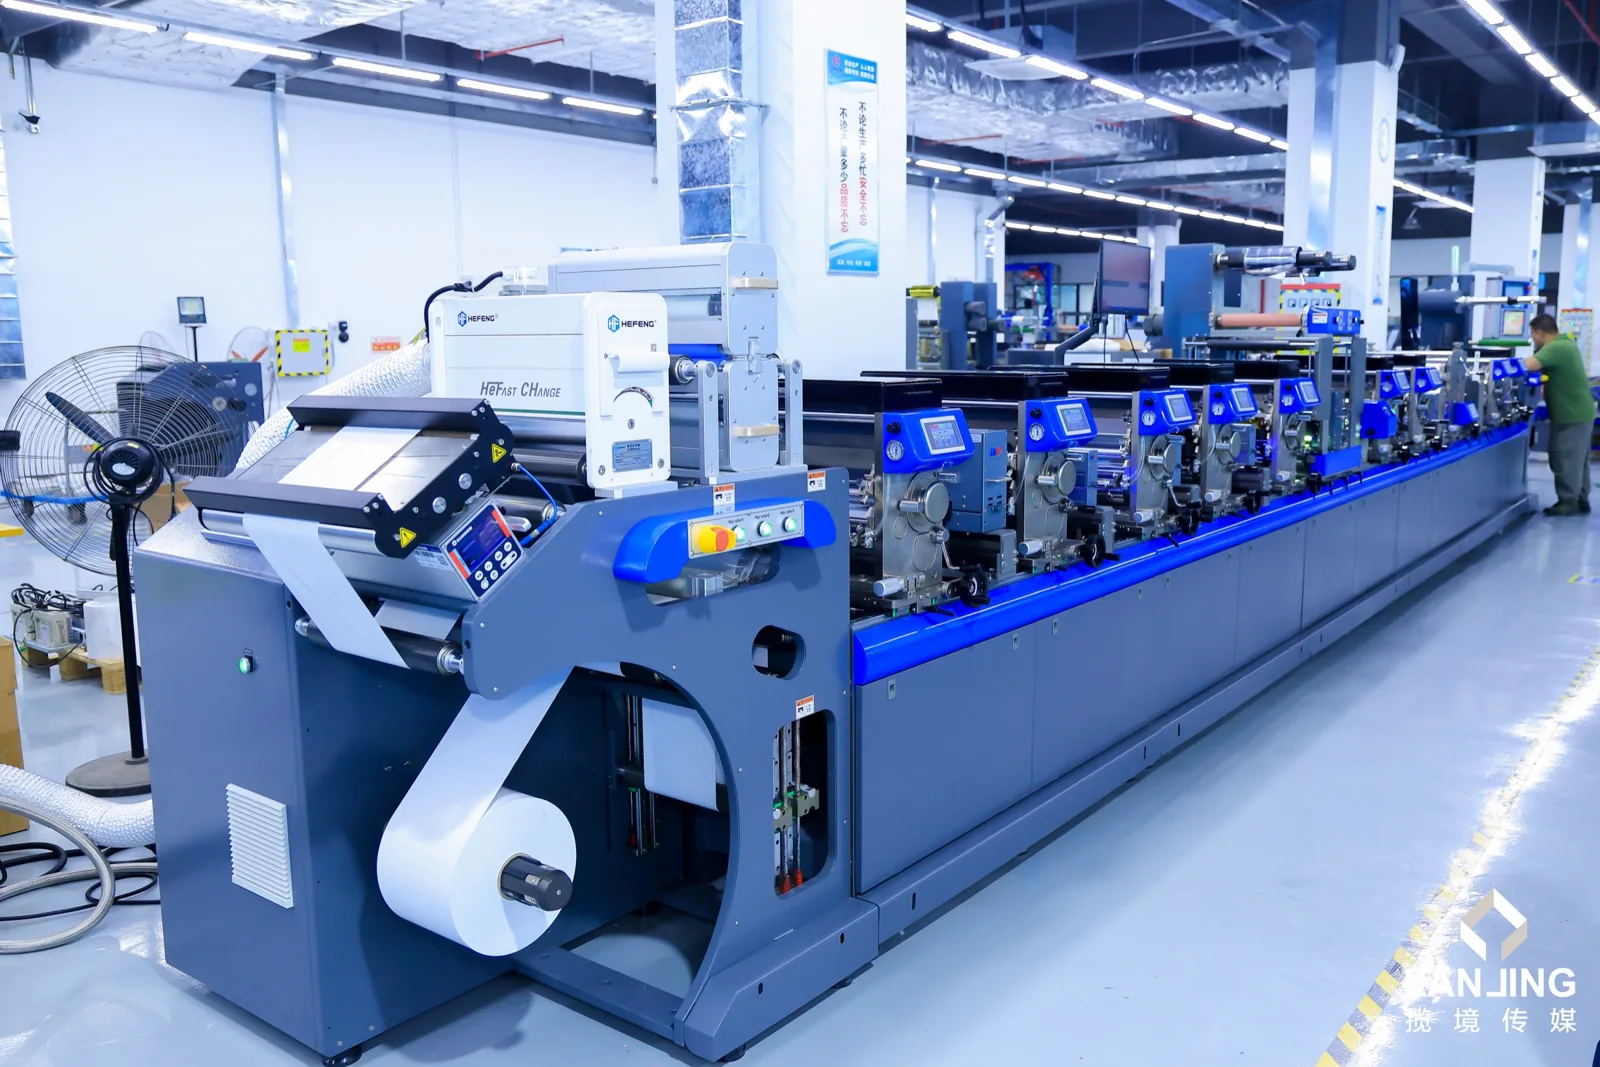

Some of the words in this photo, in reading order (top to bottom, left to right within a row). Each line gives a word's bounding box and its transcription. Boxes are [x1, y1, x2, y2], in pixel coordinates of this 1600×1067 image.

[858, 101, 867, 226] 不论生产多忙安全不忘
[621, 320, 654, 328] HEFENG
